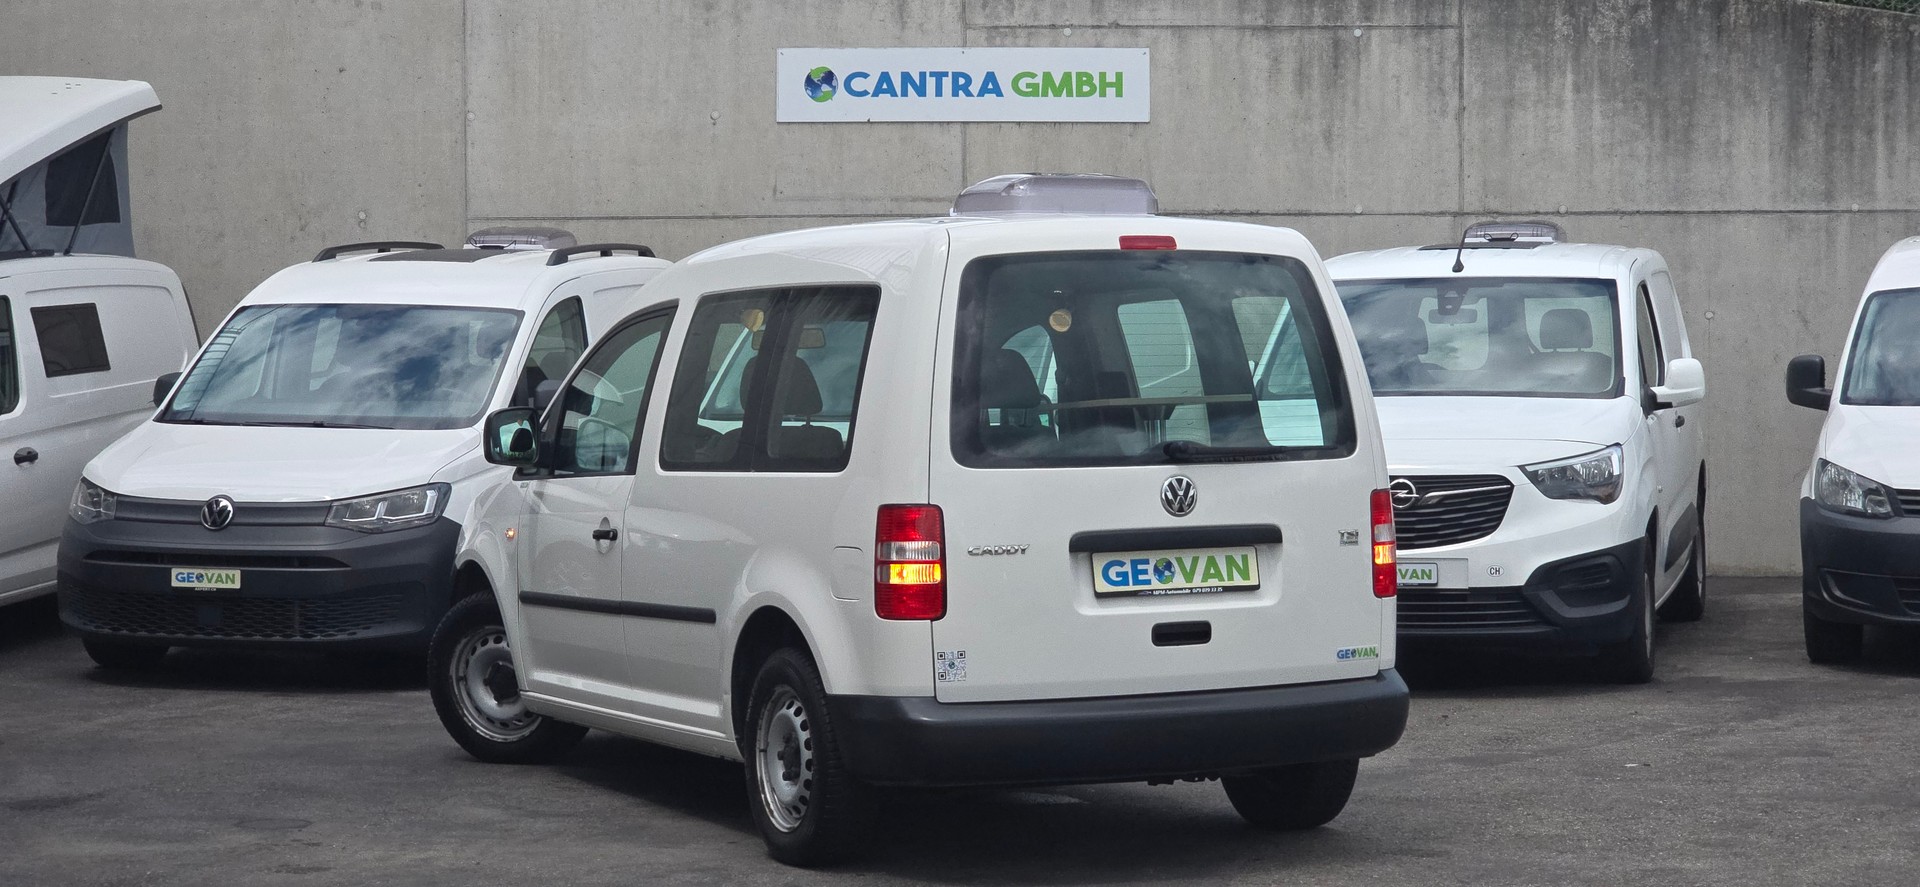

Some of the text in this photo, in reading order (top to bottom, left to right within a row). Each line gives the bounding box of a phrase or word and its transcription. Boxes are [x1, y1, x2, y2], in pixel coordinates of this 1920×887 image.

[843, 71, 1123, 98] CANTRA GMBH
[967, 544, 1030, 556] CADDY
[1101, 553, 1251, 587] GEOVAN
[1489, 567, 1501, 576] CH
[175, 572, 236, 585] GEOVAN
